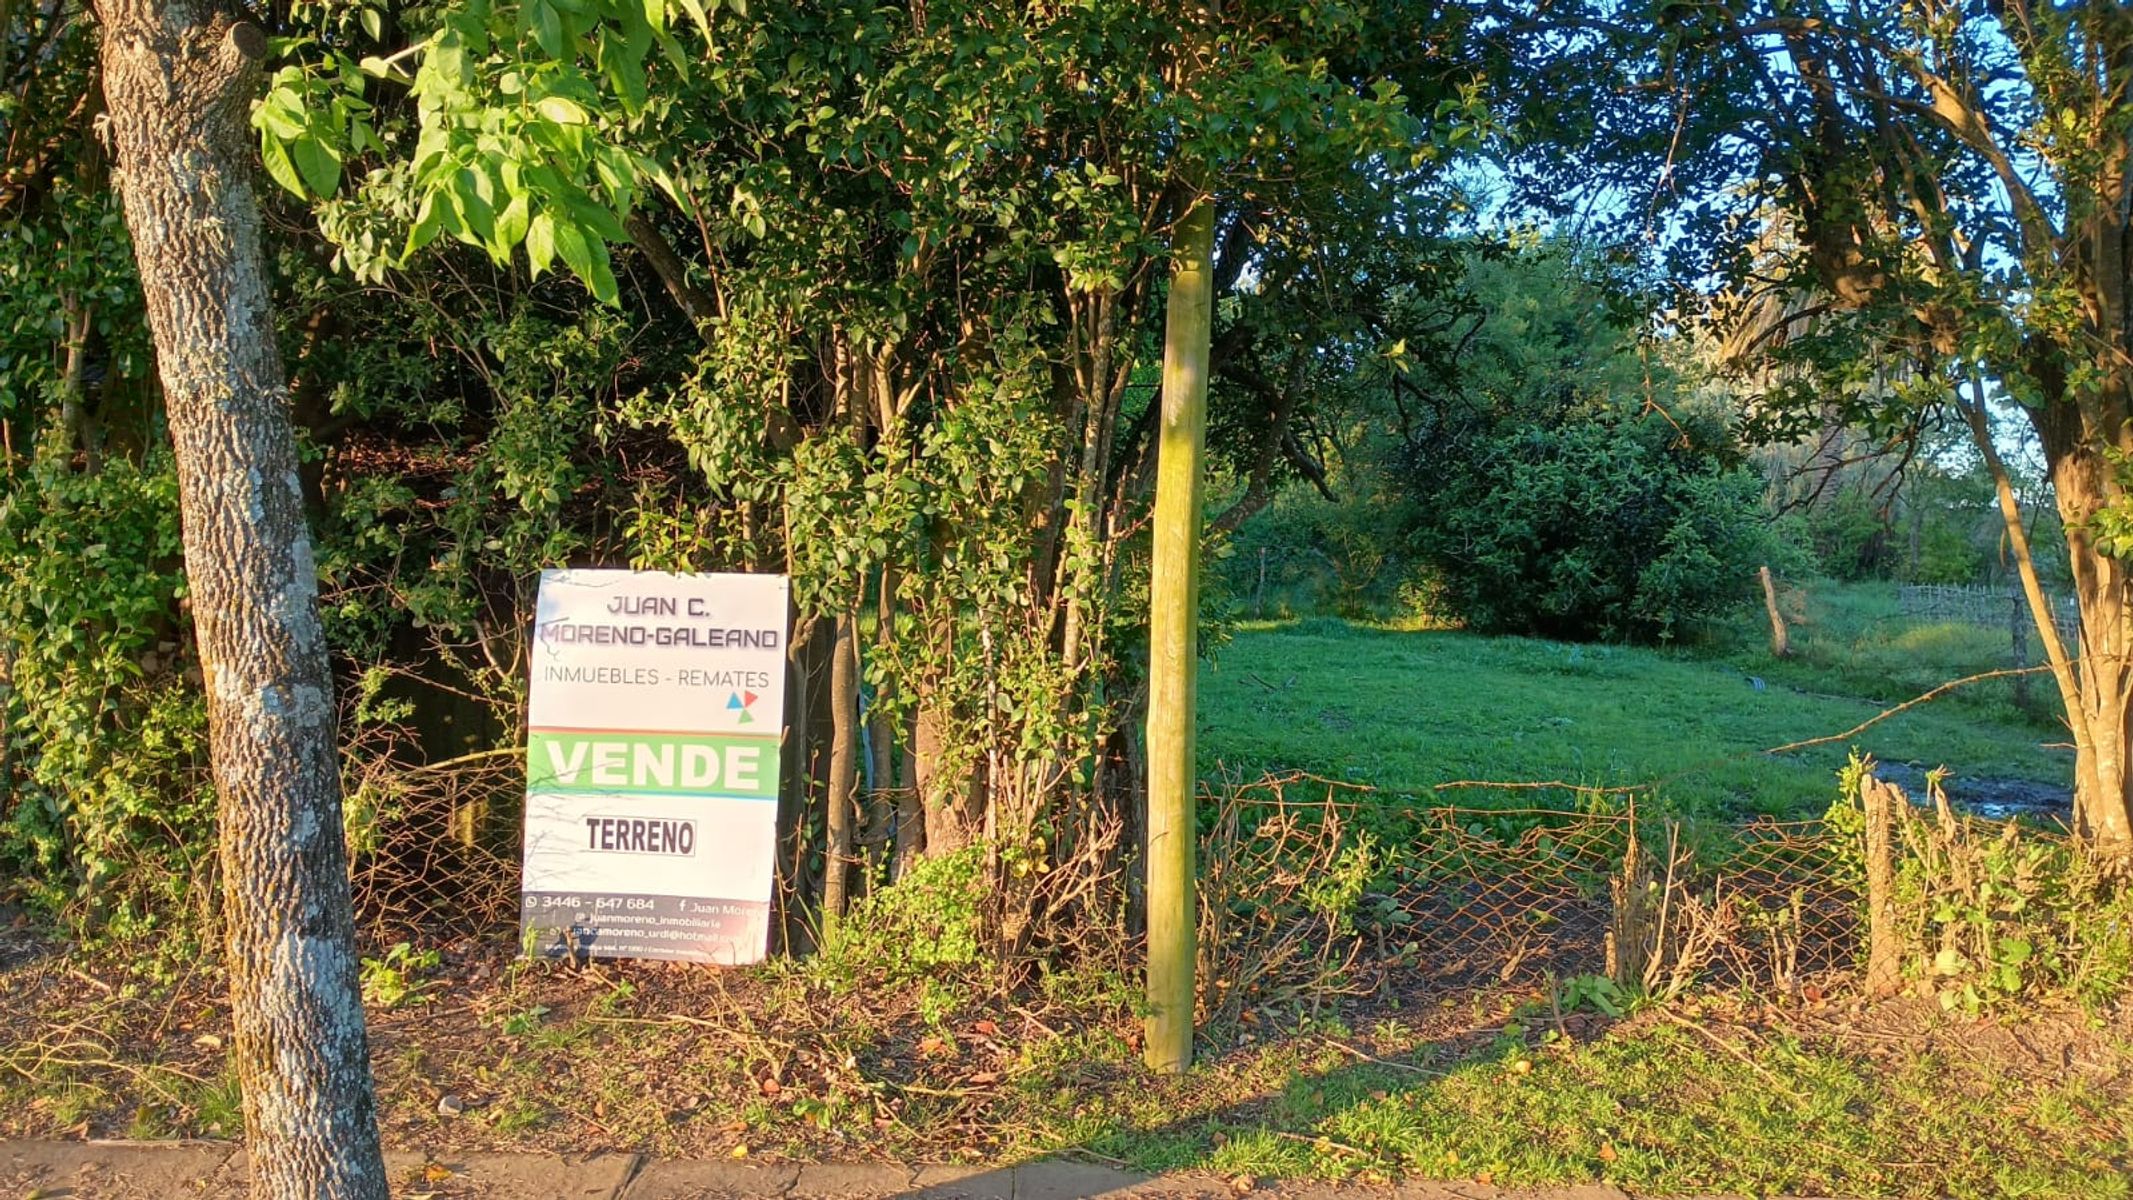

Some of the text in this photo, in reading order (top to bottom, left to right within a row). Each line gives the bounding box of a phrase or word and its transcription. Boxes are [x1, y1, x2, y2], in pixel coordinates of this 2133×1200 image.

[607, 596, 711, 617] JUAN C.
[540, 623, 778, 649] MORENO-GALEANO
[544, 665, 660, 686] INMUEBLES
[678, 669, 770, 688] REMATES
[545, 740, 760, 791] VENDE
[586, 817, 695, 854] TERRENO
[542, 895, 581, 908] 3446
[596, 897, 624, 909] 647
[626, 898, 655, 910] 684
[690, 902, 719, 914] Juan
